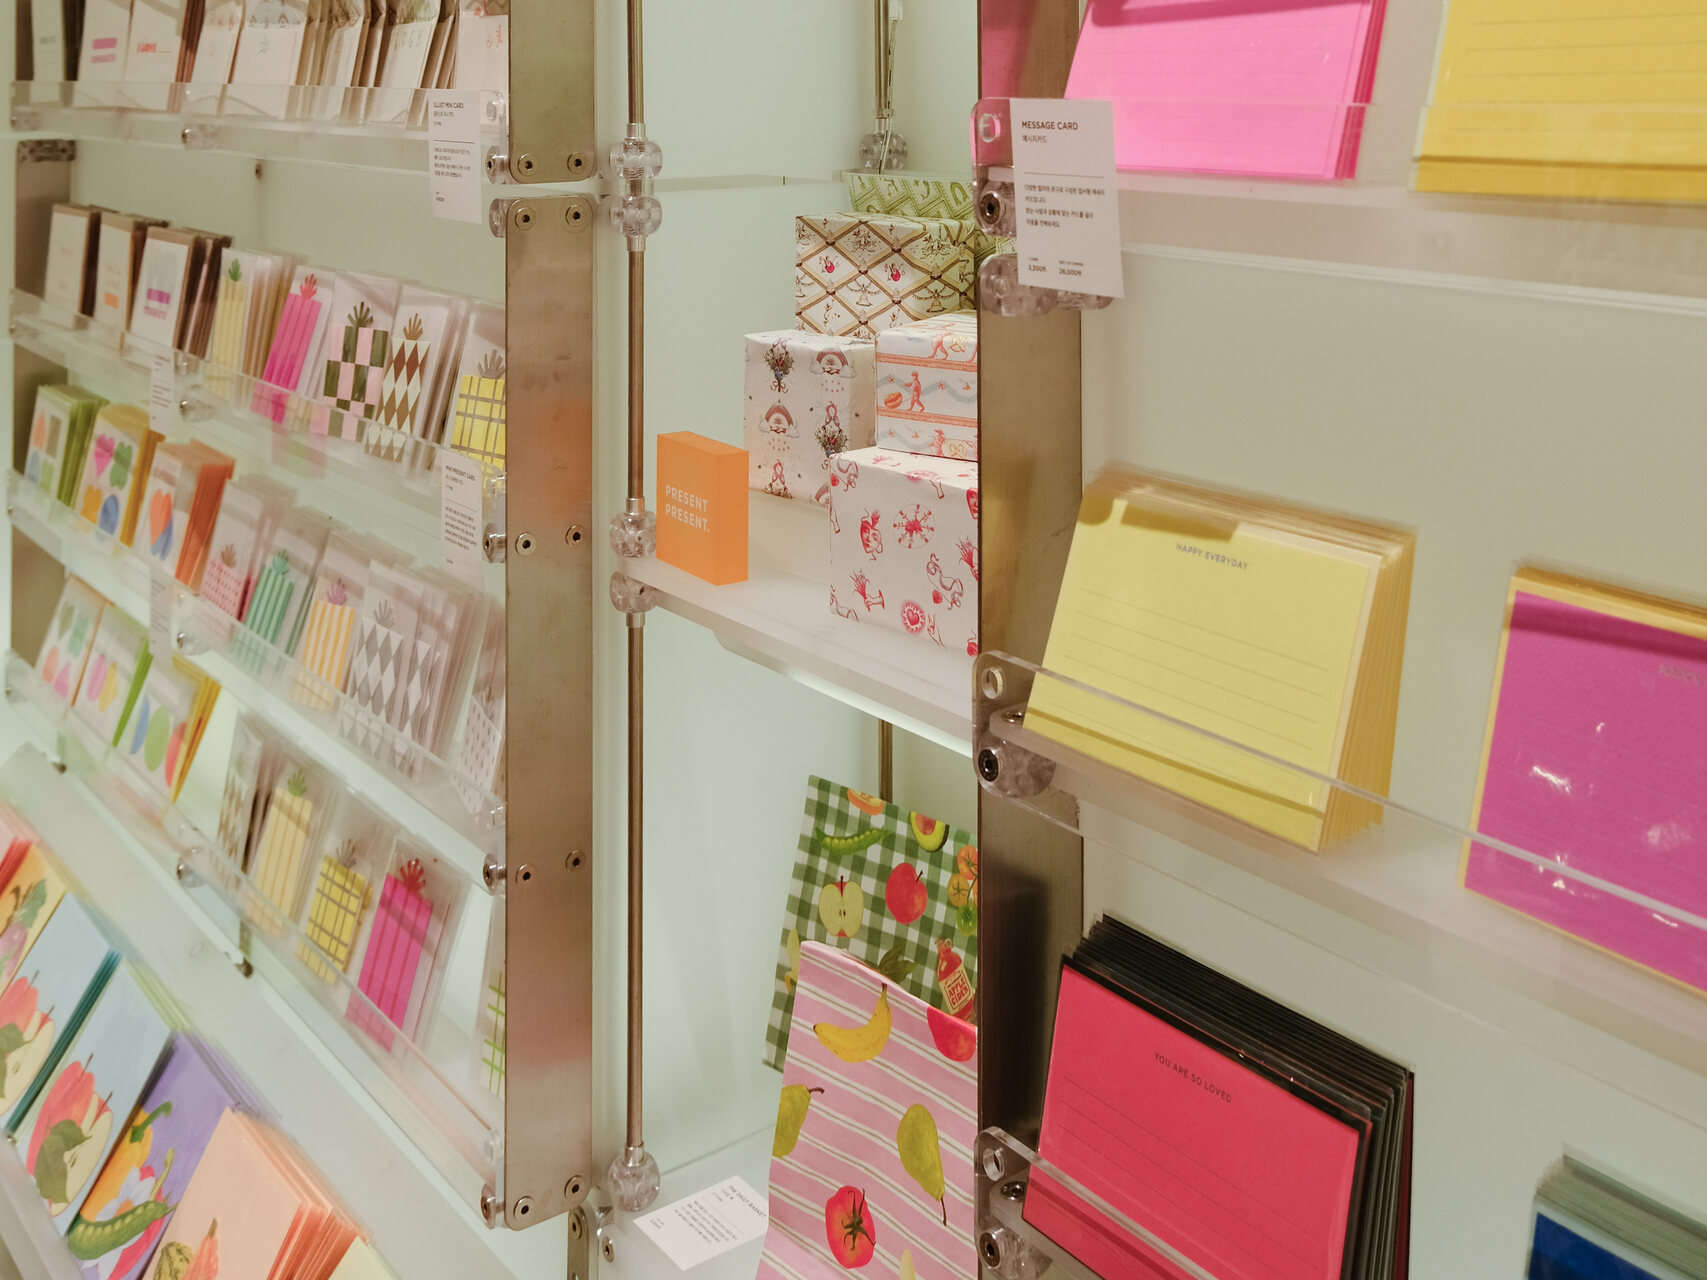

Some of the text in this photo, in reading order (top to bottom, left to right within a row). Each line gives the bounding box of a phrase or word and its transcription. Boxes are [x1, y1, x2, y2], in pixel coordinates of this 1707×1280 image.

[1021, 121, 1079, 131] MESSAGE CARD
[665, 484, 709, 512] PRESENT
[665, 503, 711, 533] PRESENT.
[1176, 543, 1249, 570] HAPPY EVERYDAY
[948, 976, 966, 998] APPLE
[951, 985, 970, 1007] CIDER
[1154, 1052, 1233, 1103] YOU ARE SO LOVED
